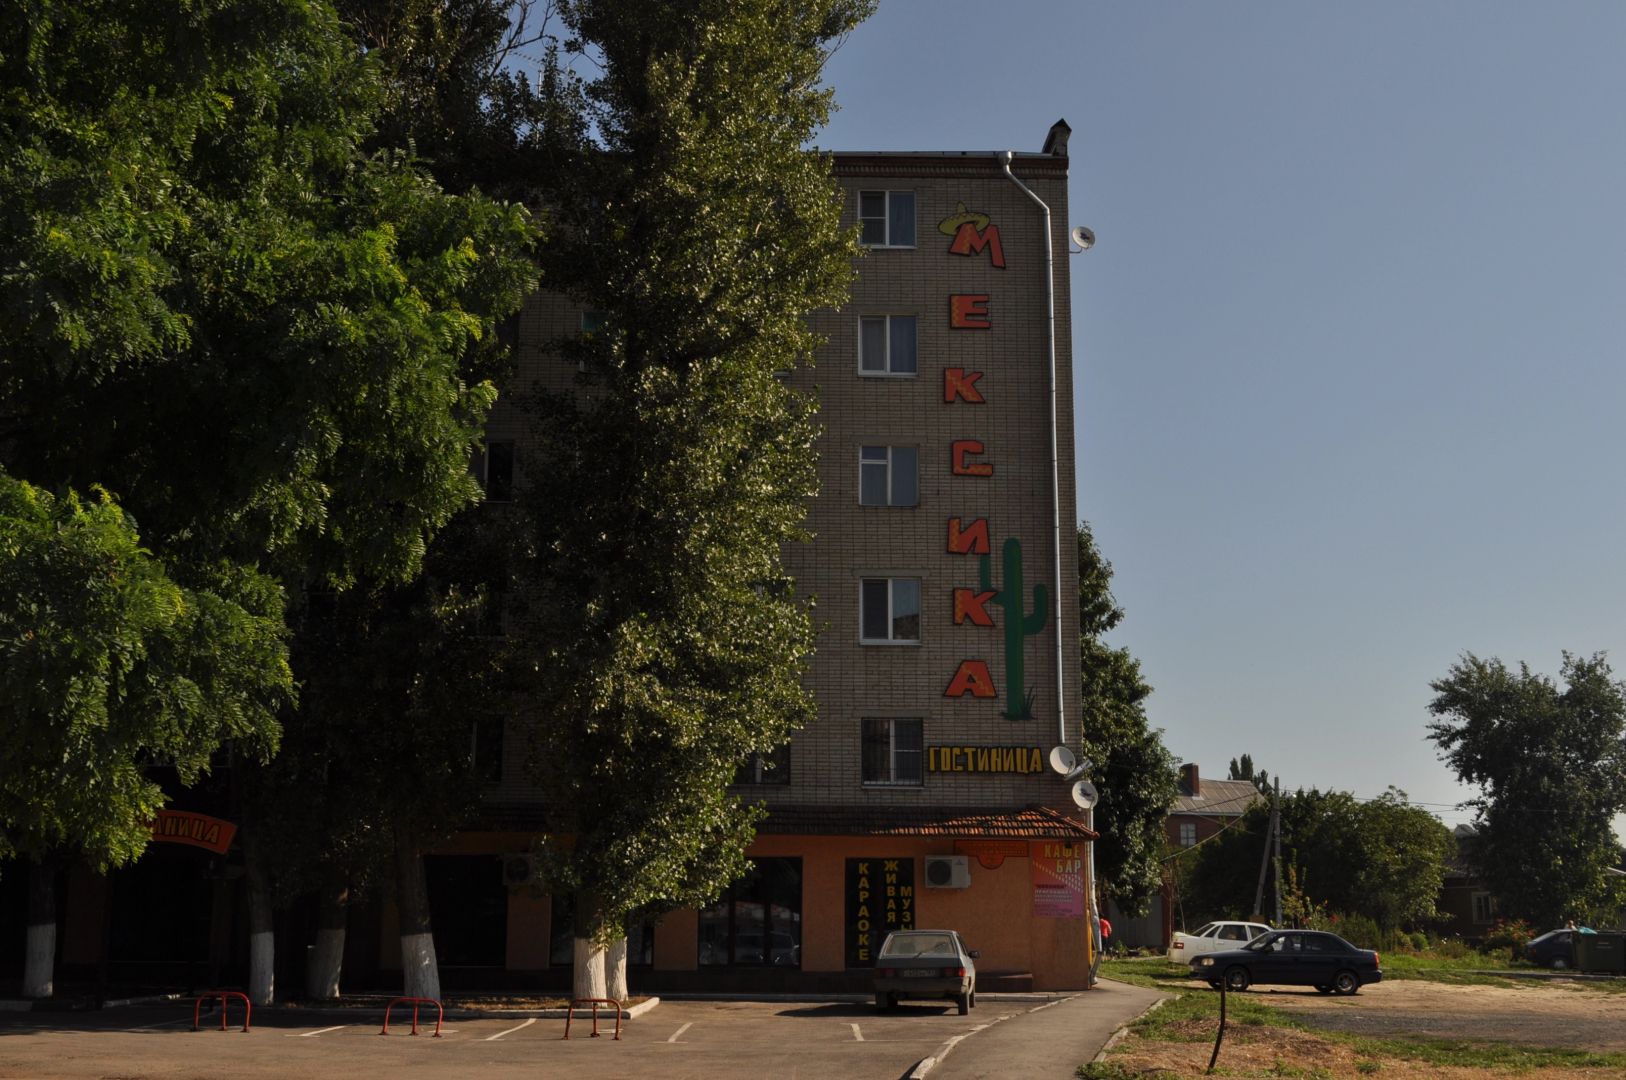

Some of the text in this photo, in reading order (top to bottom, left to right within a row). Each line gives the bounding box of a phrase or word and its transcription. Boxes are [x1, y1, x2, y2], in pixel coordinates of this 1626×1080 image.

[943, 221, 1006, 698] МЕКСИКА
[928, 746, 1044, 774] ГОСТИНИЦА
[150, 815, 221, 845] ИНИЦА
[985, 857, 997, 867] 83
[1044, 843, 1081, 858] КАФЕ
[1056, 859, 1081, 874] БАР
[883, 860, 899, 923] ЖИВАЯ
[857, 862, 870, 961] КАРАОКЕ
[900, 886, 914, 931] МУЗЫ
